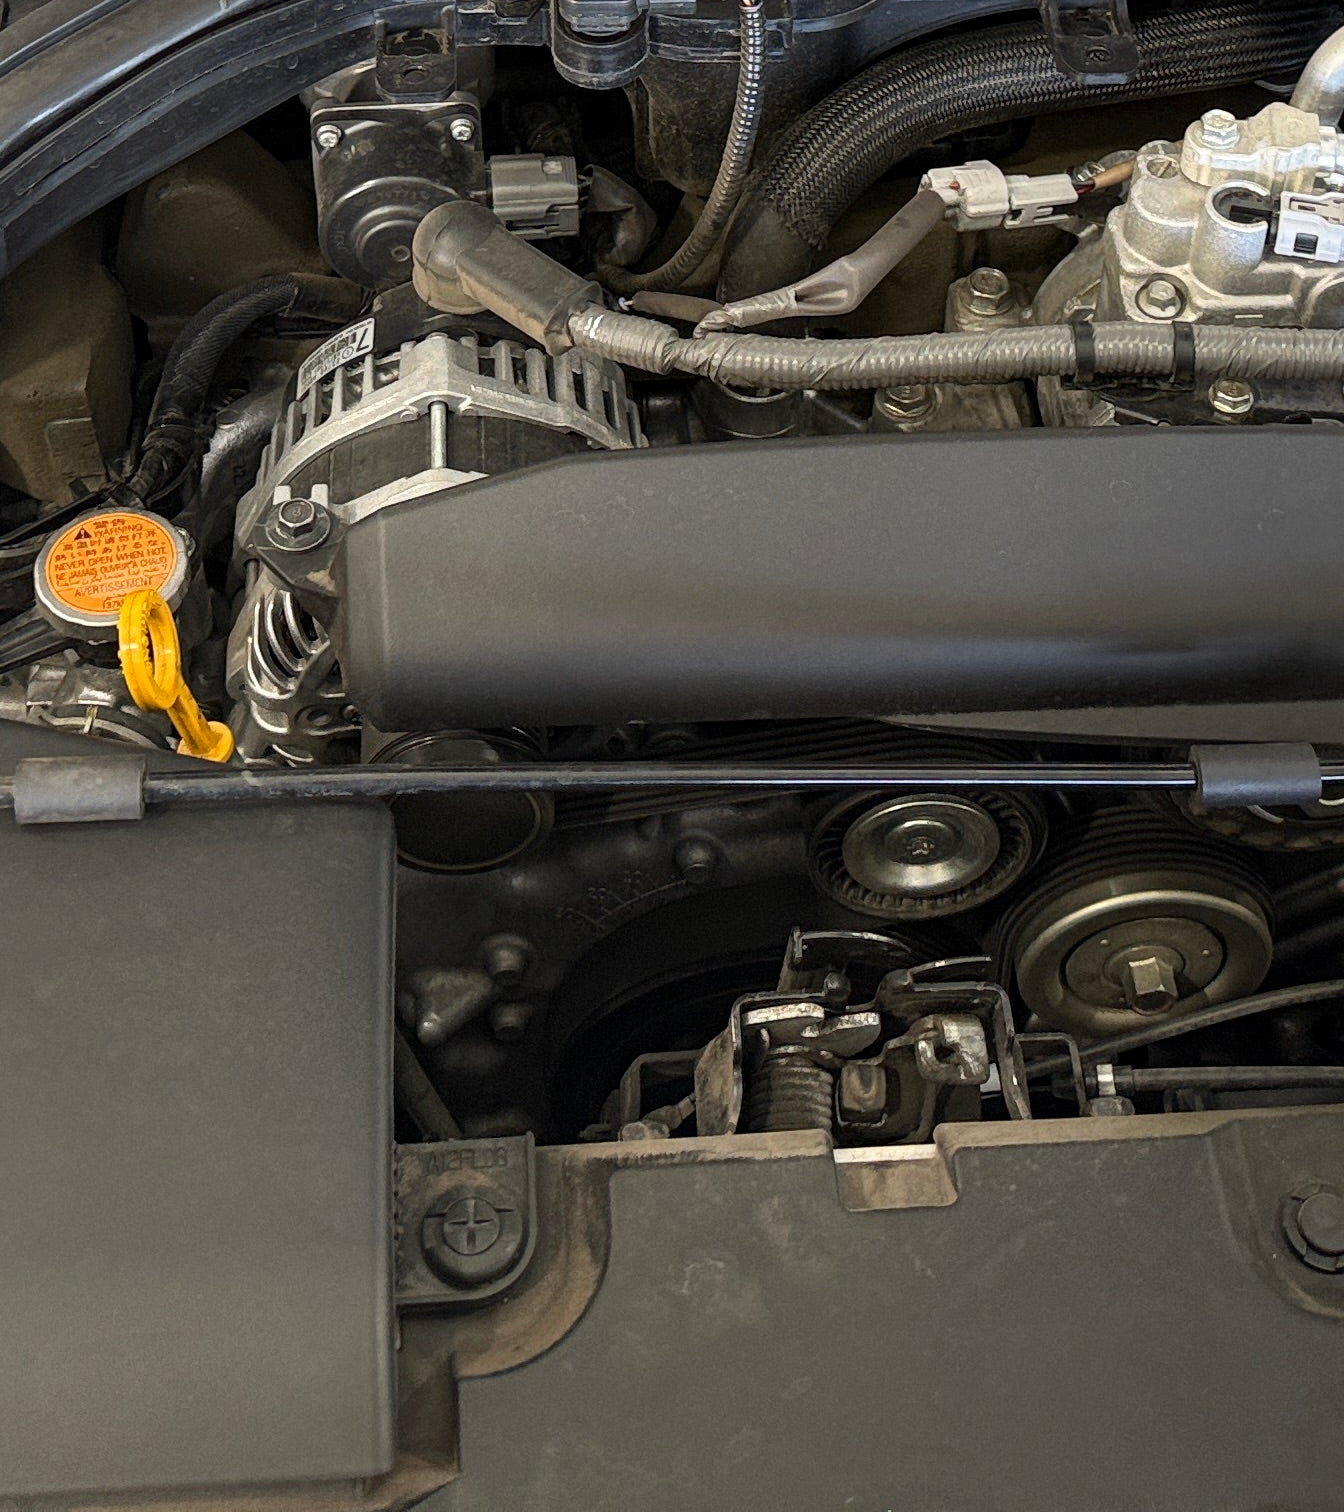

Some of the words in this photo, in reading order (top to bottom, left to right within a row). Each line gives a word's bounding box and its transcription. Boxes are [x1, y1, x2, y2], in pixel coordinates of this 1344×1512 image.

[94, 524, 143, 538] WARNING
[55, 560, 85, 571] NEVER
[89, 555, 113, 567] OPEN
[117, 550, 144, 561] WHEN
[147, 546, 167, 555] HOT
[75, 576, 153, 597] AVERTISSEMENT
